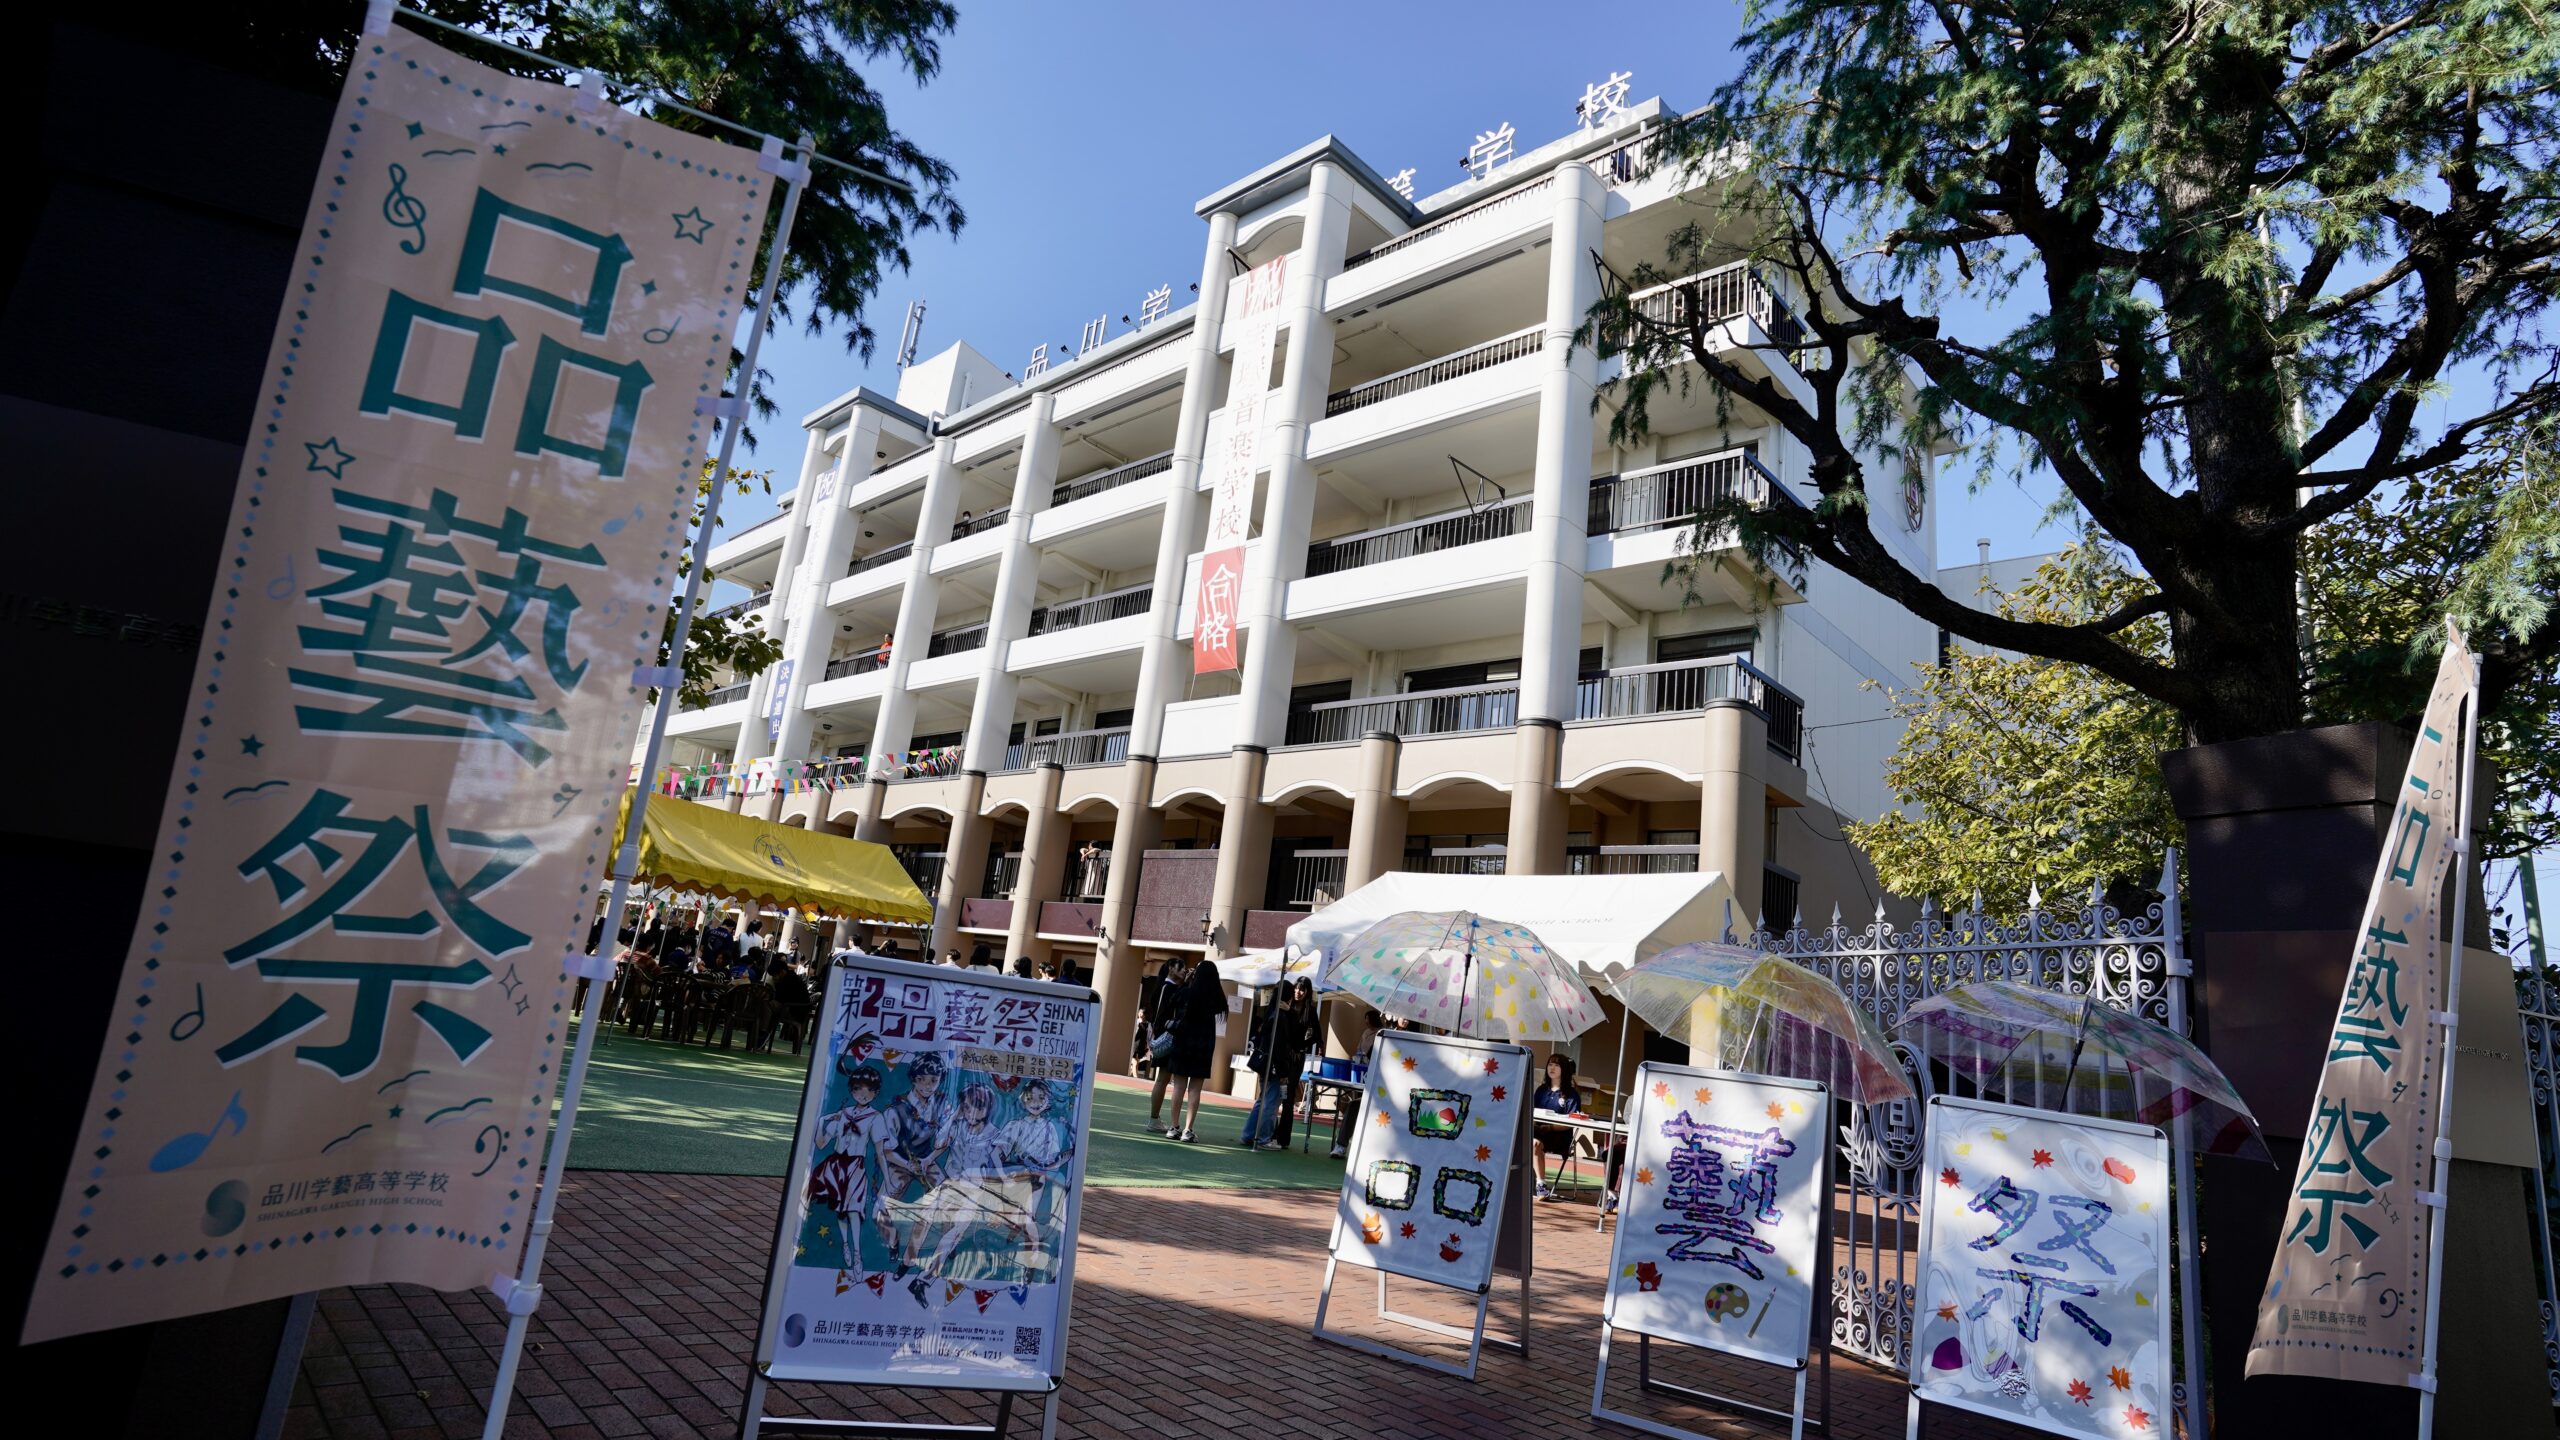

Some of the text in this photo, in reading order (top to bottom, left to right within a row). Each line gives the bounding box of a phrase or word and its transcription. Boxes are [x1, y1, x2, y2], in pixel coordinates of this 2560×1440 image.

[1024, 283, 1172, 380] 品川学
[215, 187, 655, 1082] 品藝祭
[1198, 563, 1238, 652] 合格
[1038, 1036, 1080, 1057] FESTIVAL
[1040, 1020, 1064, 1036] GEI
[1043, 1002, 1086, 1023] SHINA
[256, 1196, 444, 1222] SHINAGAWA GAKUGEI HIGH SCHOOL
[1656, 1110, 1797, 1280] 藝
[1966, 1175, 2117, 1347] 祭
